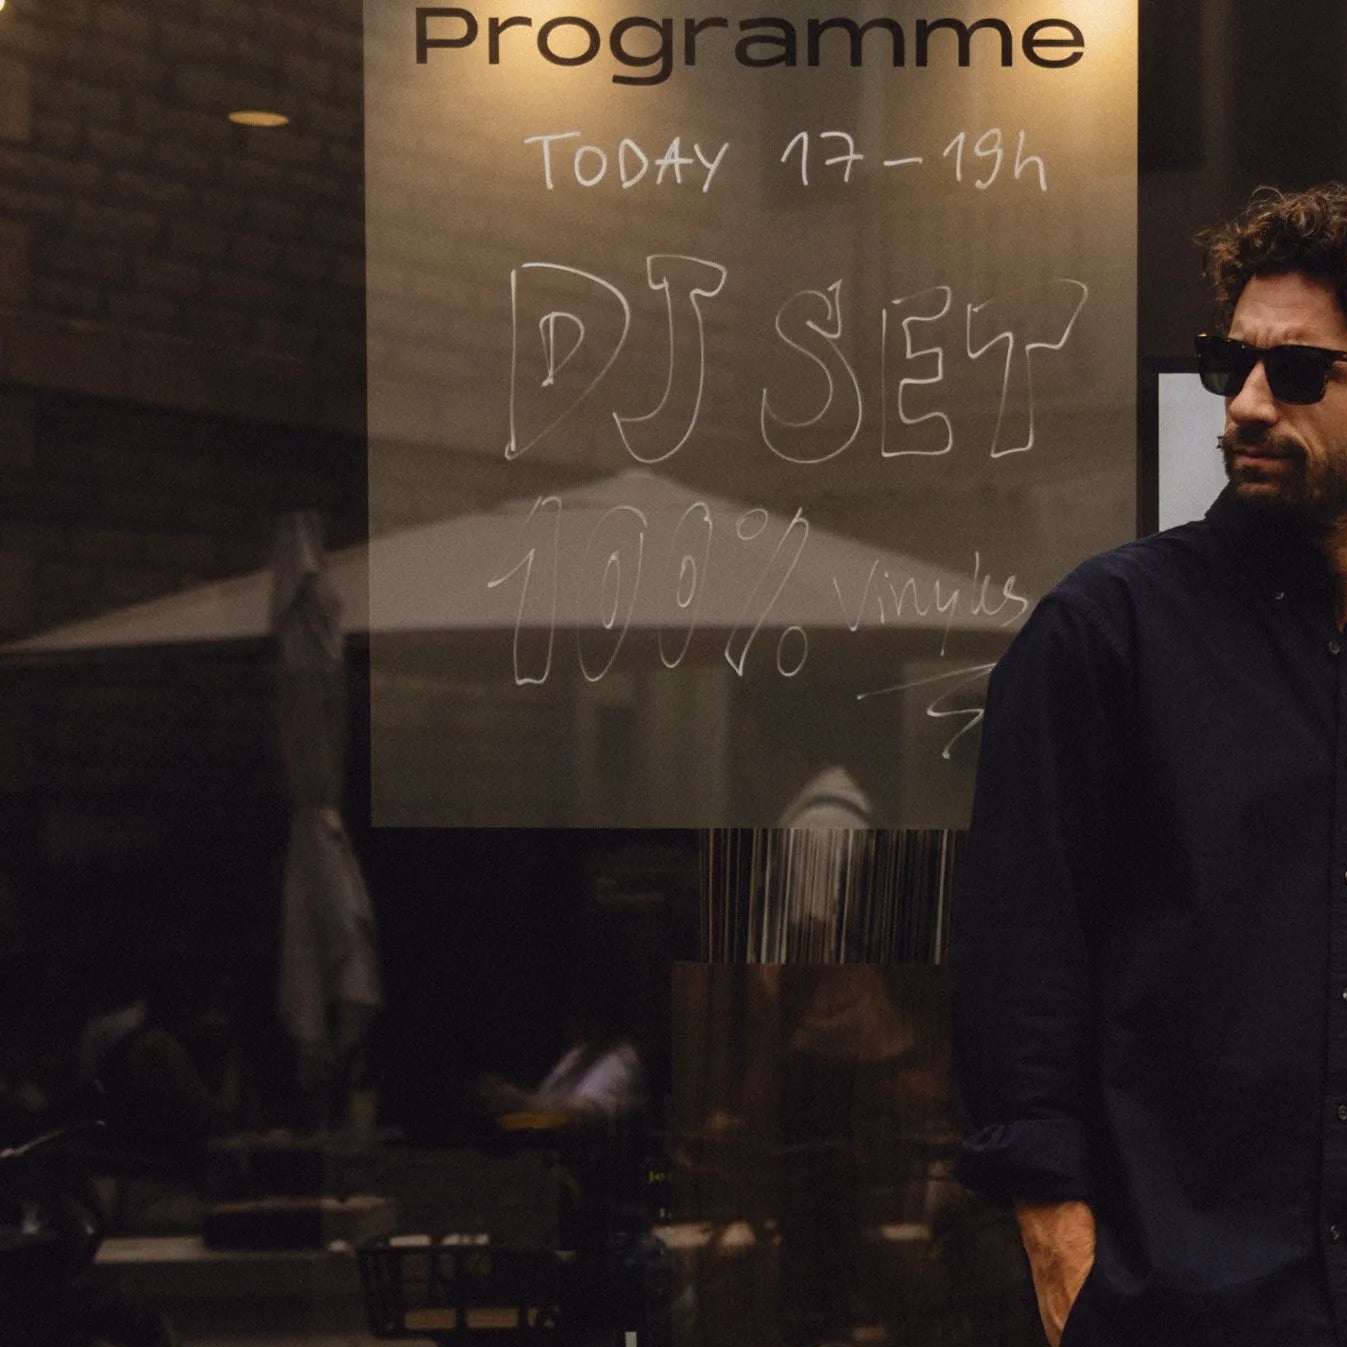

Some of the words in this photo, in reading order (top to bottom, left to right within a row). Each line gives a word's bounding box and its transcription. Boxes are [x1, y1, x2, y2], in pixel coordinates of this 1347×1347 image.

[415, 7, 1086, 85] Programme
[524, 131, 729, 192] TODAY
[505, 254, 728, 463] DJ
[760, 278, 1089, 463] SET
[487, 496, 809, 686] 100%
